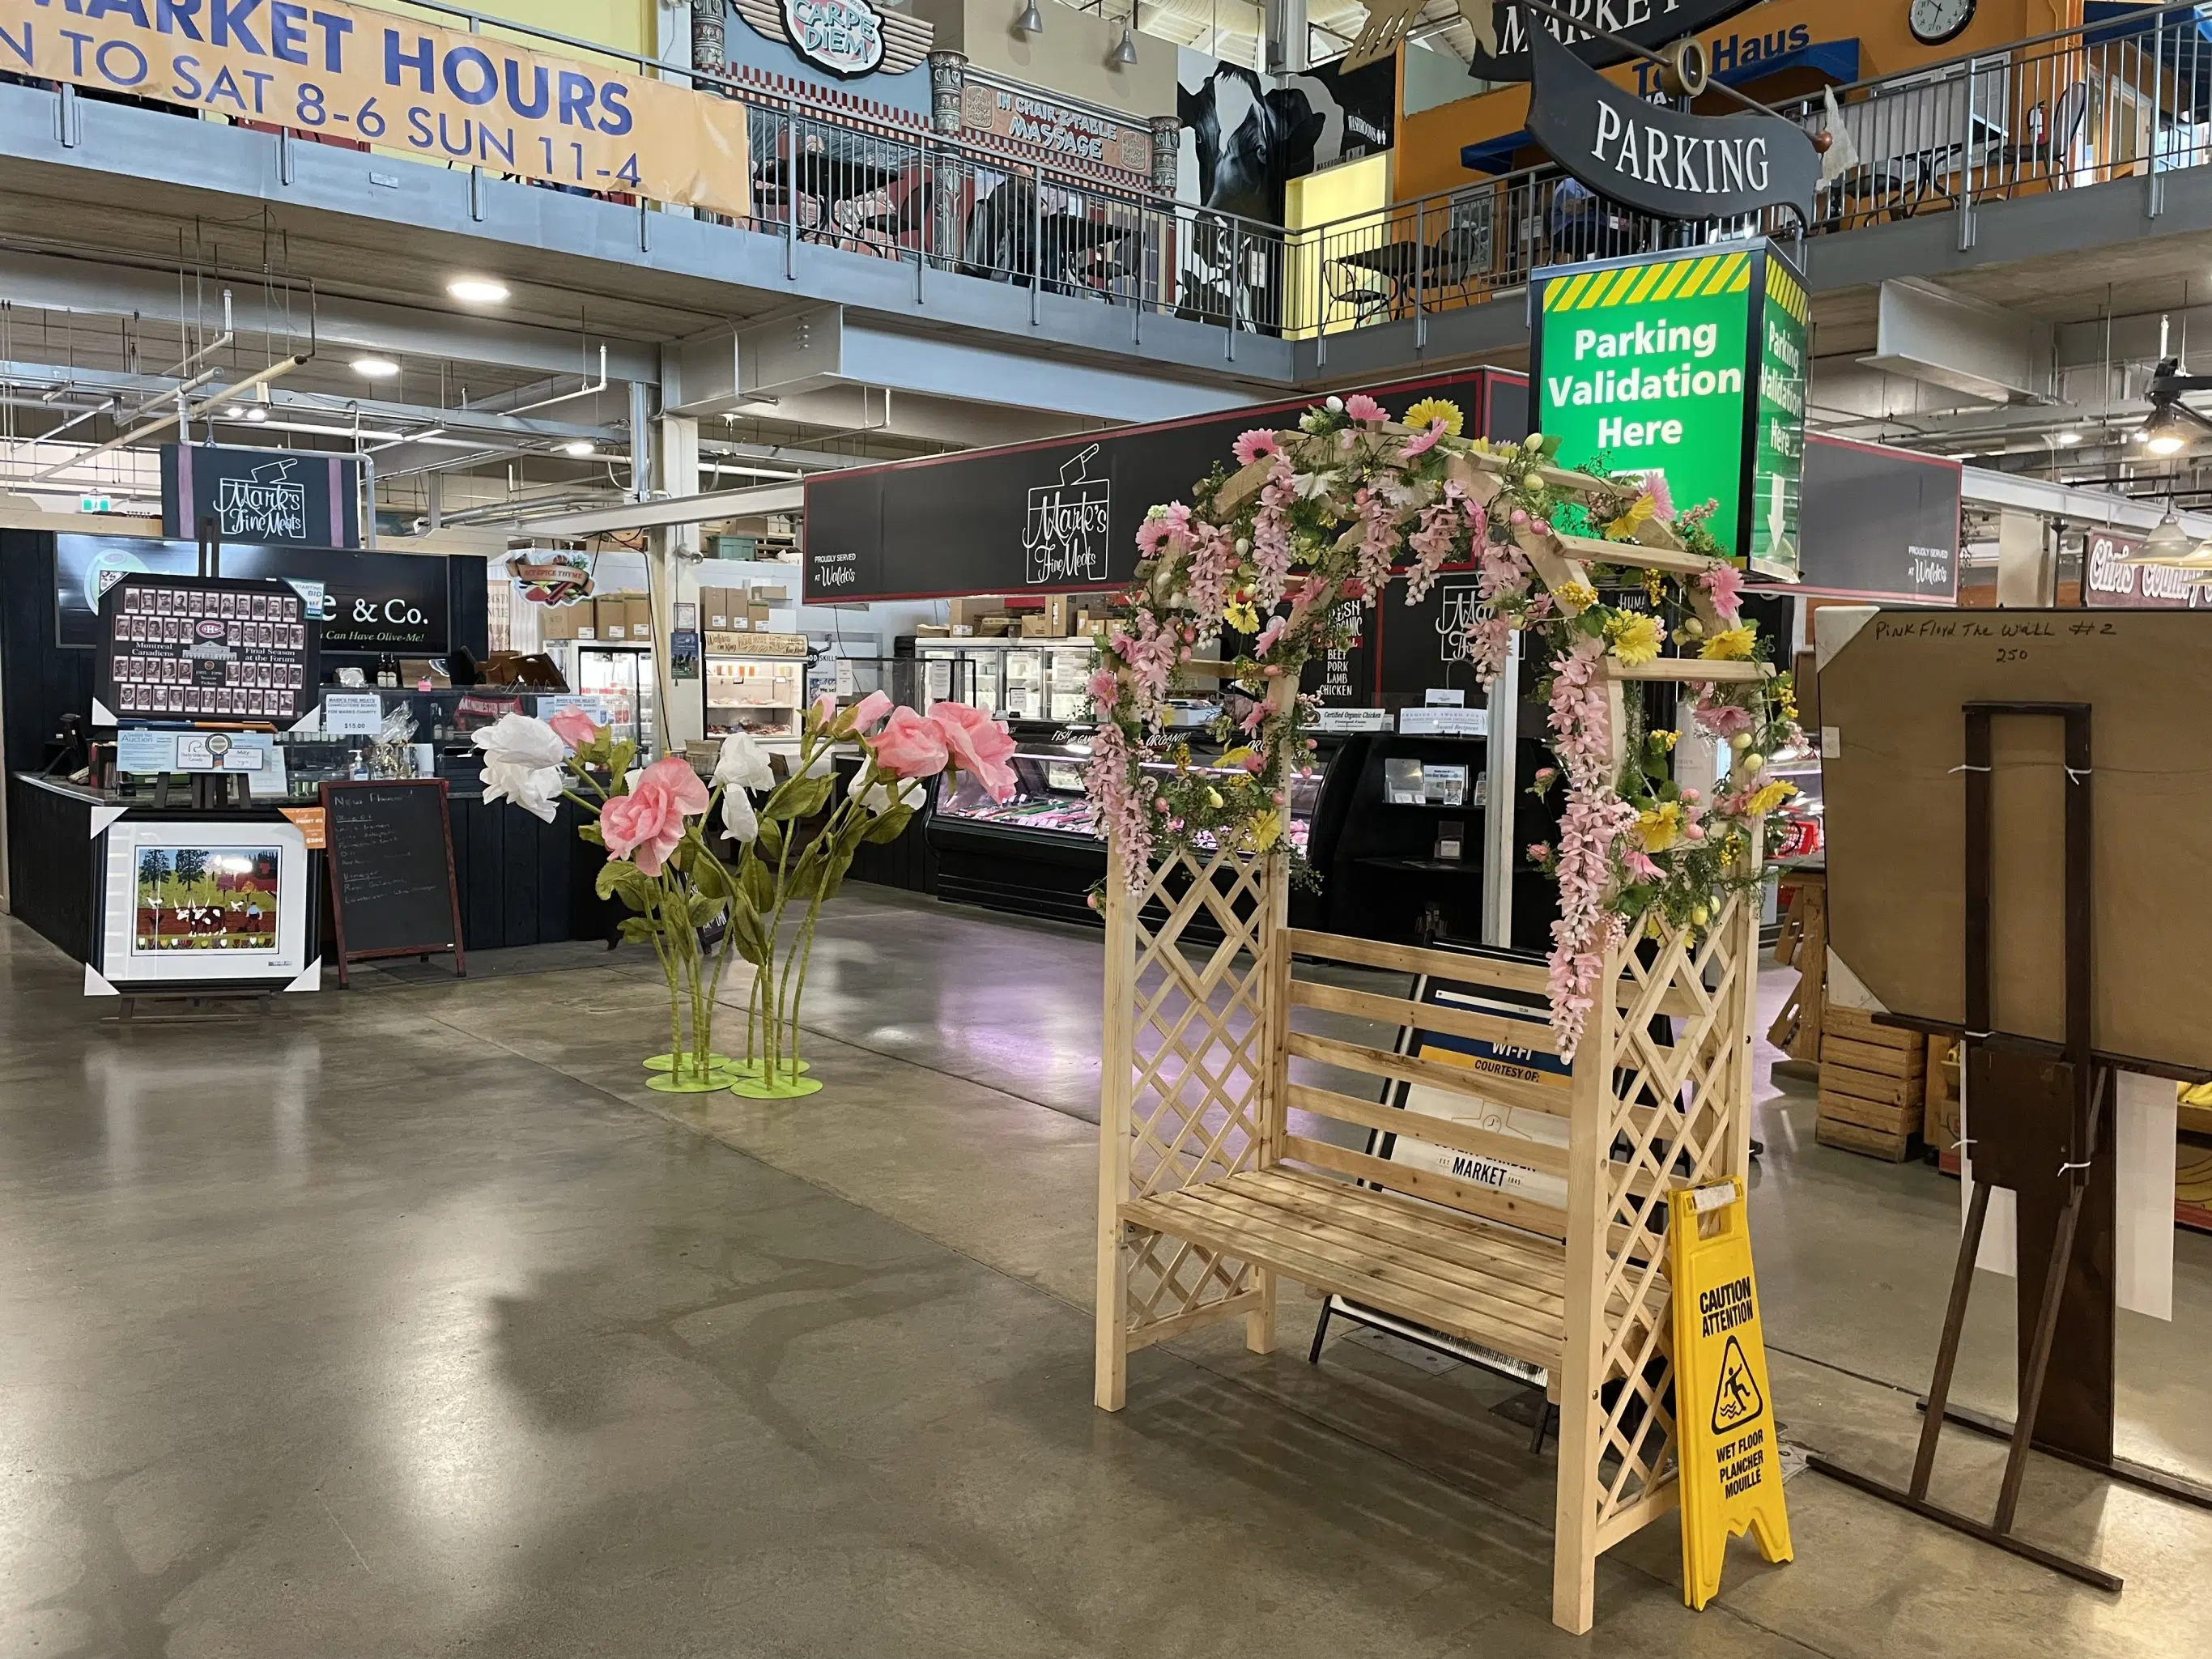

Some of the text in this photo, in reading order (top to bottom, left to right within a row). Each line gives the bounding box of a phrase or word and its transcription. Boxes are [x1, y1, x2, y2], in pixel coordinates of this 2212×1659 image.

[793, 0, 875, 44] CARPE
[1499, 0, 1680, 55] MARKE
[803, 25, 868, 63] DIEM
[1712, 23, 1810, 75] Haus
[33, 0, 633, 136] RKET HOURS
[59, 29, 149, 86] TO
[172, 55, 274, 114] SAT
[296, 83, 385, 138] 8-6
[407, 106, 515, 167] SUN
[538, 136, 642, 188] 11-4
[997, 91, 1011, 111] IN
[1015, 97, 1056, 124] CHAIR
[1072, 114, 1117, 141] TABLE
[1009, 117, 1103, 160] MASSAGE
[1591, 100, 1768, 194] PARKING
[1574, 319, 1717, 360] Parking
[1768, 320, 1799, 378] Parking
[1548, 363, 1742, 407] Validation
[1760, 362, 1802, 418] Validation
[1597, 418, 1683, 449] Here
[1771, 418, 1790, 457] Here
[213, 481, 300, 513] Mark's
[229, 508, 301, 539] Fine Meats
[1022, 491, 1107, 549] Mark's
[814, 553, 857, 564] PROUDLY SERVED
[1035, 538, 1096, 581] Fine Meats
[1914, 558, 1947, 585] Waldo's
[820, 565, 856, 586] Waldo's
[307, 589, 322, 598] BID
[352, 598, 378, 623] &
[385, 598, 428, 625] Co.
[1332, 616, 1363, 638] RGANIC
[1435, 590, 1496, 634] Mar
[325, 631, 347, 640] Can
[349, 631, 374, 641] Have
[376, 632, 425, 643] Olive-Me!
[1963, 622, 1993, 636] The
[132, 648, 174, 657] Canadiens
[135, 641, 172, 651] Montreal
[245, 647, 296, 657] Final Season
[253, 655, 268, 663] the
[270, 655, 296, 664] Forum
[1327, 649, 1346, 661] BEEF
[1996, 649, 2028, 663] 250
[1326, 673, 1348, 684] LAMB
[1327, 661, 1349, 672] PORK
[1319, 684, 1352, 696] CHICKEN
[1324, 711, 1381, 721] Certified Organic Chicken
[1052, 730, 1071, 742] FISH
[1492, 1041, 1533, 1061] WI-FI
[1474, 1059, 1541, 1083] COURTESY OF:
[1453, 1156, 1507, 1188] MARKET
[1699, 1275, 1751, 1315] CAUTION
[1702, 1300, 1754, 1338] ATTENTION
[1716, 1428, 1763, 1465] WET FLOOR
[1720, 1450, 1764, 1483] PLANCHER
[1725, 1466, 1762, 1500] MOUILLÉ
